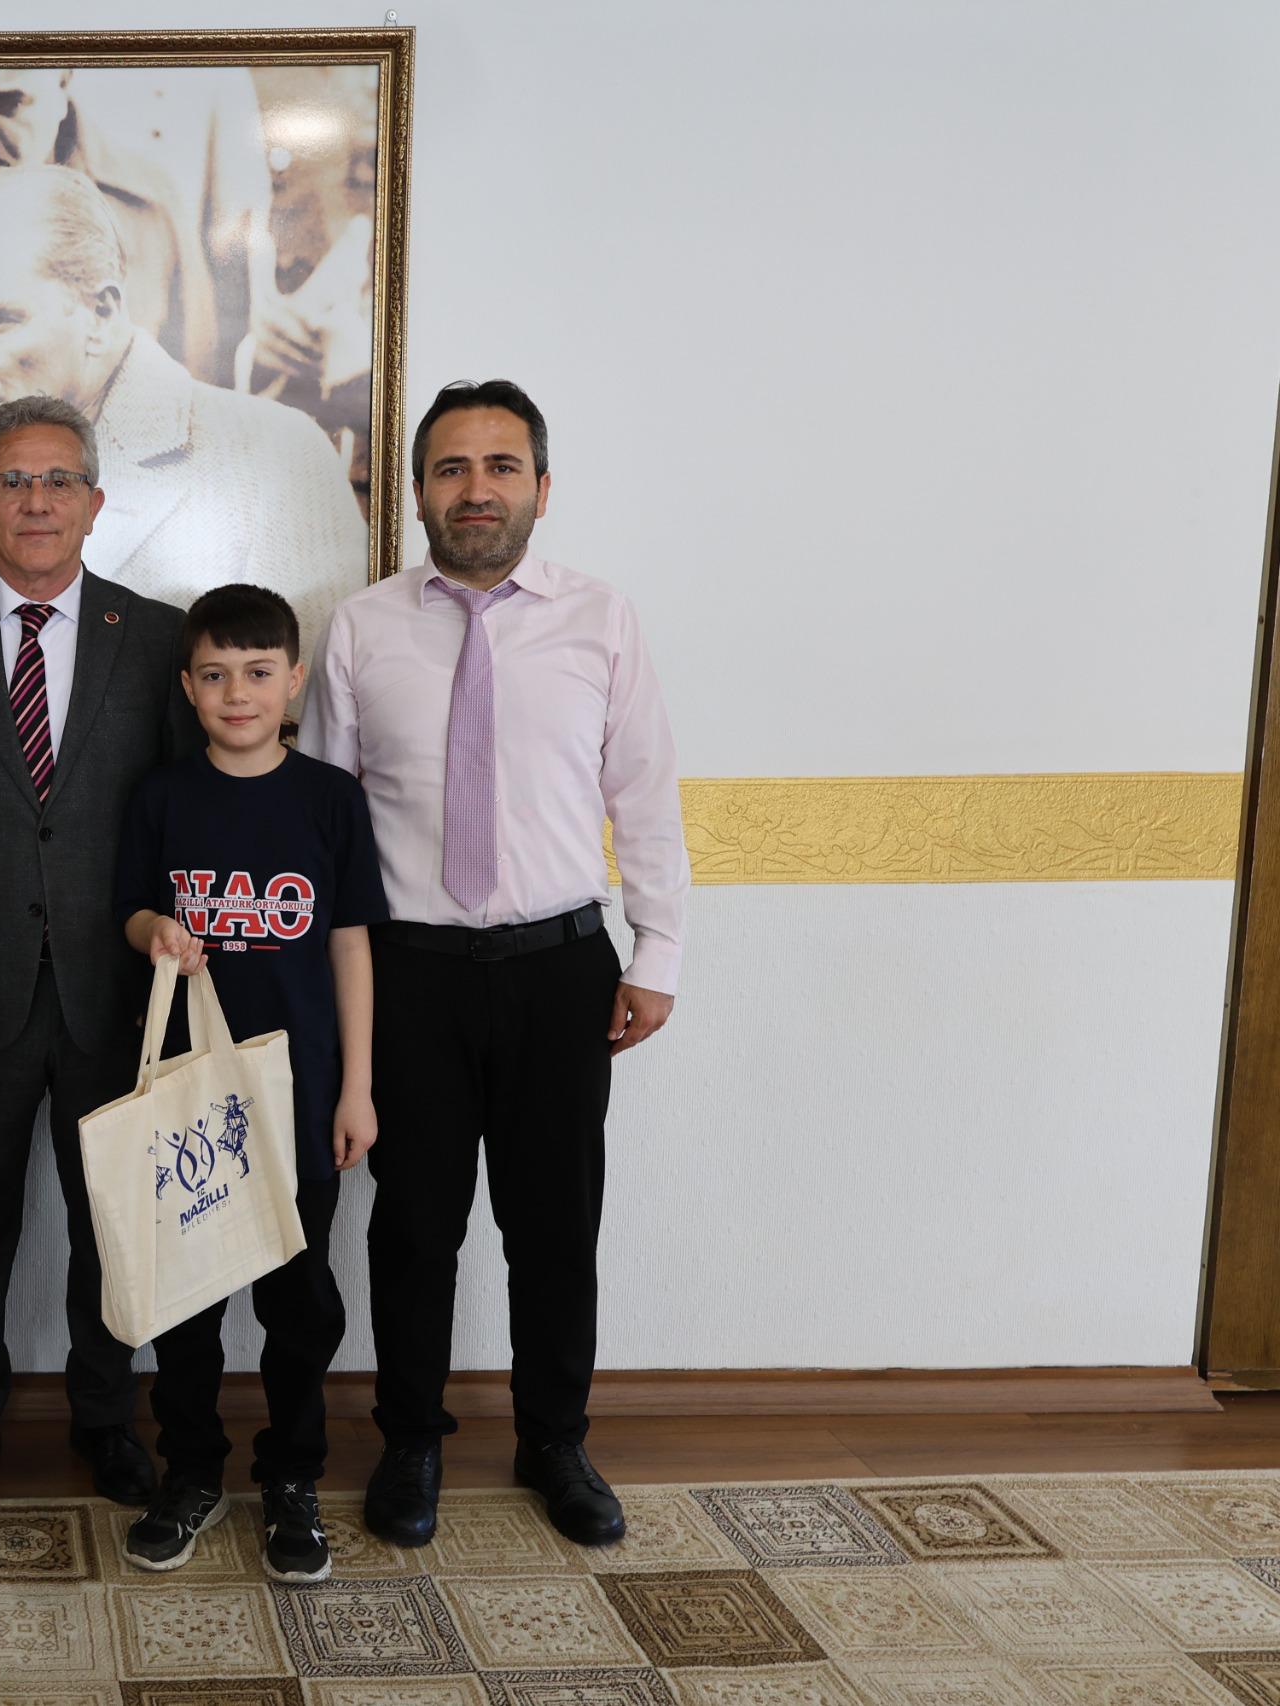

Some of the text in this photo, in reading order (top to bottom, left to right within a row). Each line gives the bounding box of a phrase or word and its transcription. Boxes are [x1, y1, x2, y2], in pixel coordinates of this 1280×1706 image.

[205, 897, 254, 909] ATATÜRK
[254, 899, 313, 912] ORTAOKULU
[223, 941, 247, 952] 1958
